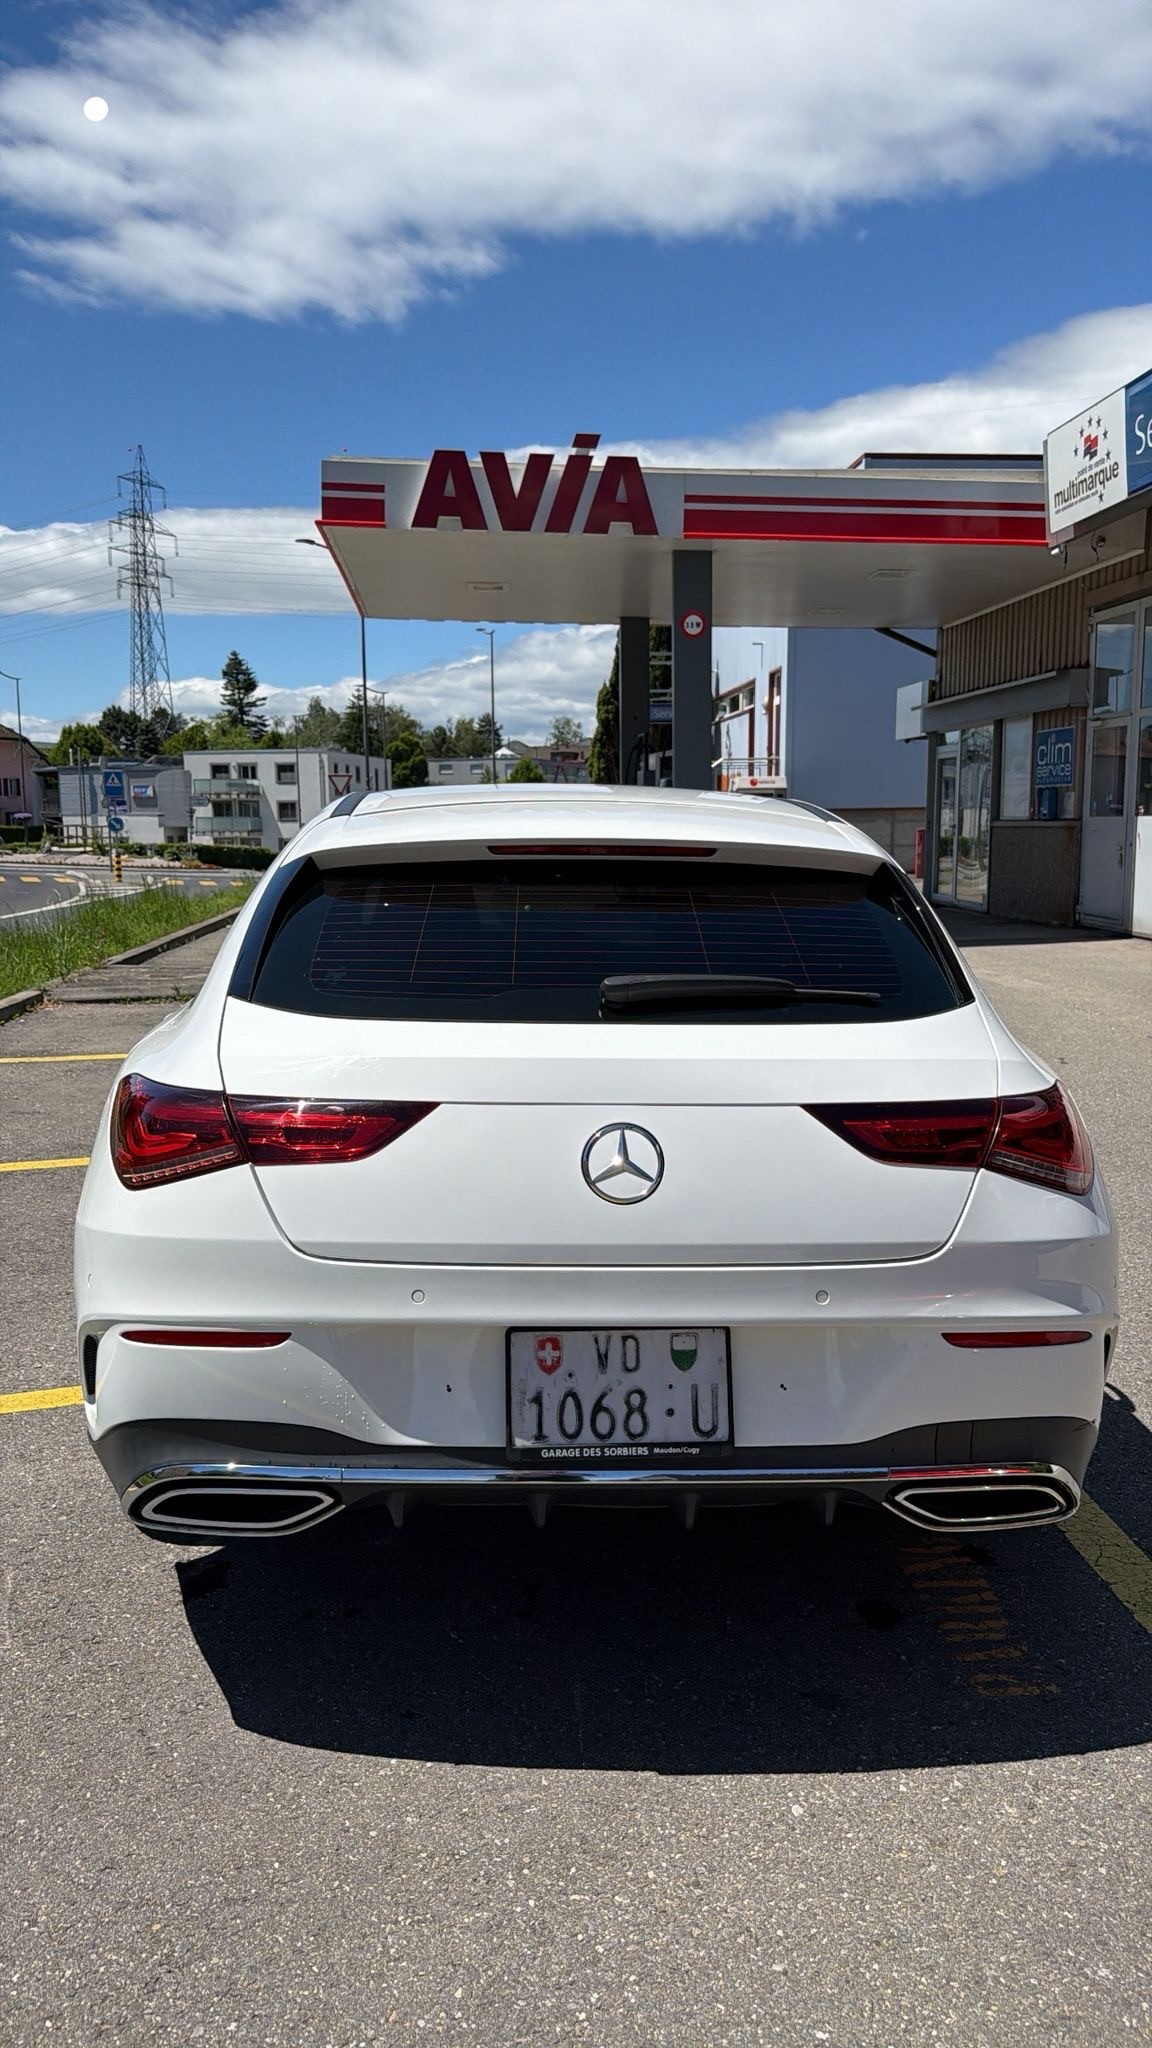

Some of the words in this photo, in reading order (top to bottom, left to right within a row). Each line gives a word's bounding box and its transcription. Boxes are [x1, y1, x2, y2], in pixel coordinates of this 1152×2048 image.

[411, 433, 659, 536] AVIA
[1054, 461, 1119, 509] multimarque
[1037, 734, 1072, 765] clim
[1037, 763, 1071, 777] service
[593, 1334, 640, 1374] VD
[527, 1386, 649, 1442] 1068
[541, 1448, 580, 1458] GARAGE
[583, 1447, 601, 1457] DES
[604, 1446, 649, 1456] SORBIERS
